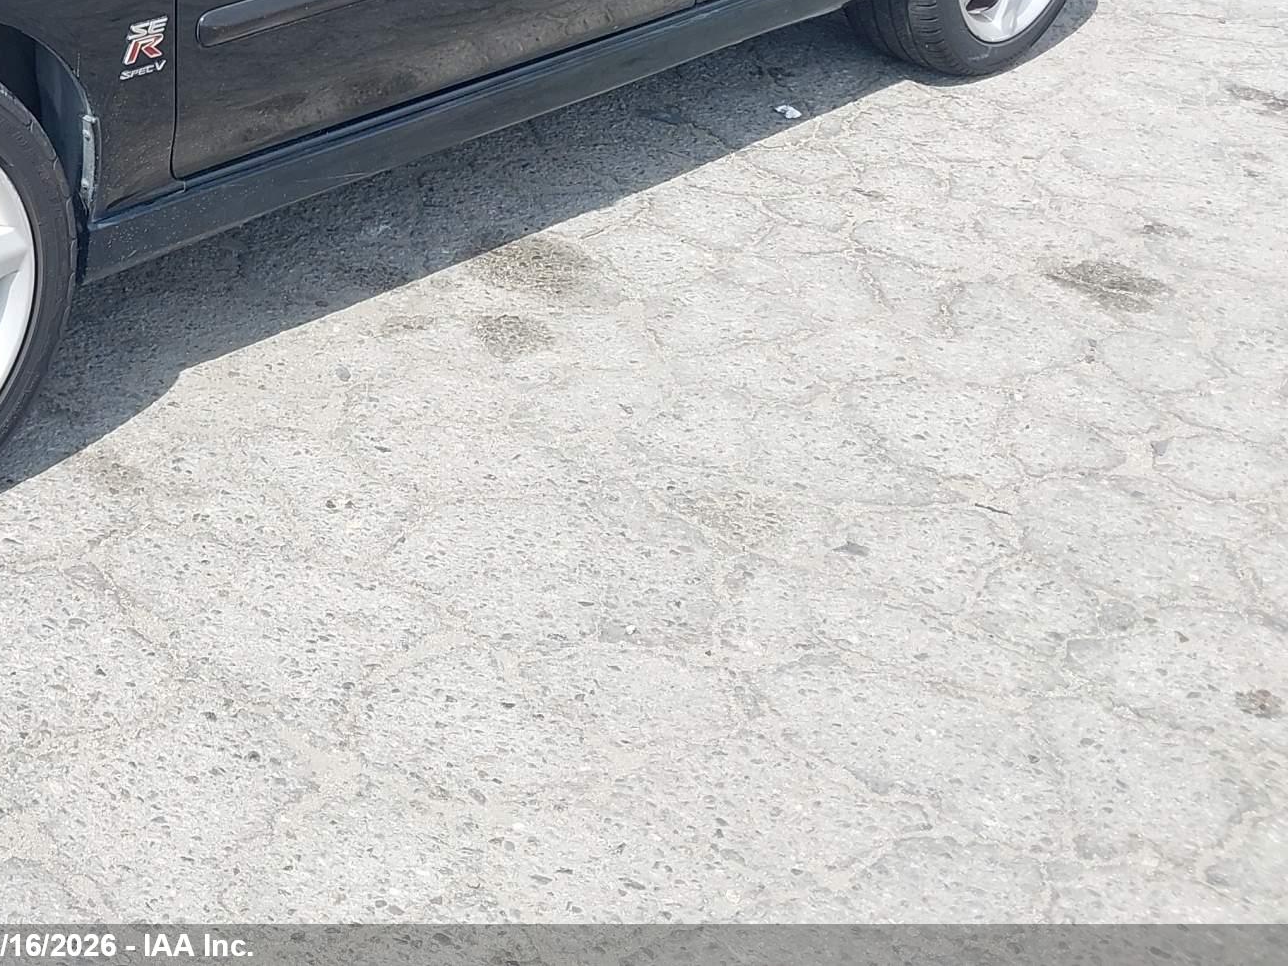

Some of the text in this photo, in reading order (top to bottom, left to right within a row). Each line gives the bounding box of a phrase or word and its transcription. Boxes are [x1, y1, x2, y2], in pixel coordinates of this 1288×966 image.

[126, 15, 168, 41] SE
[123, 33, 164, 66] R
[119, 64, 155, 81] SPEC
